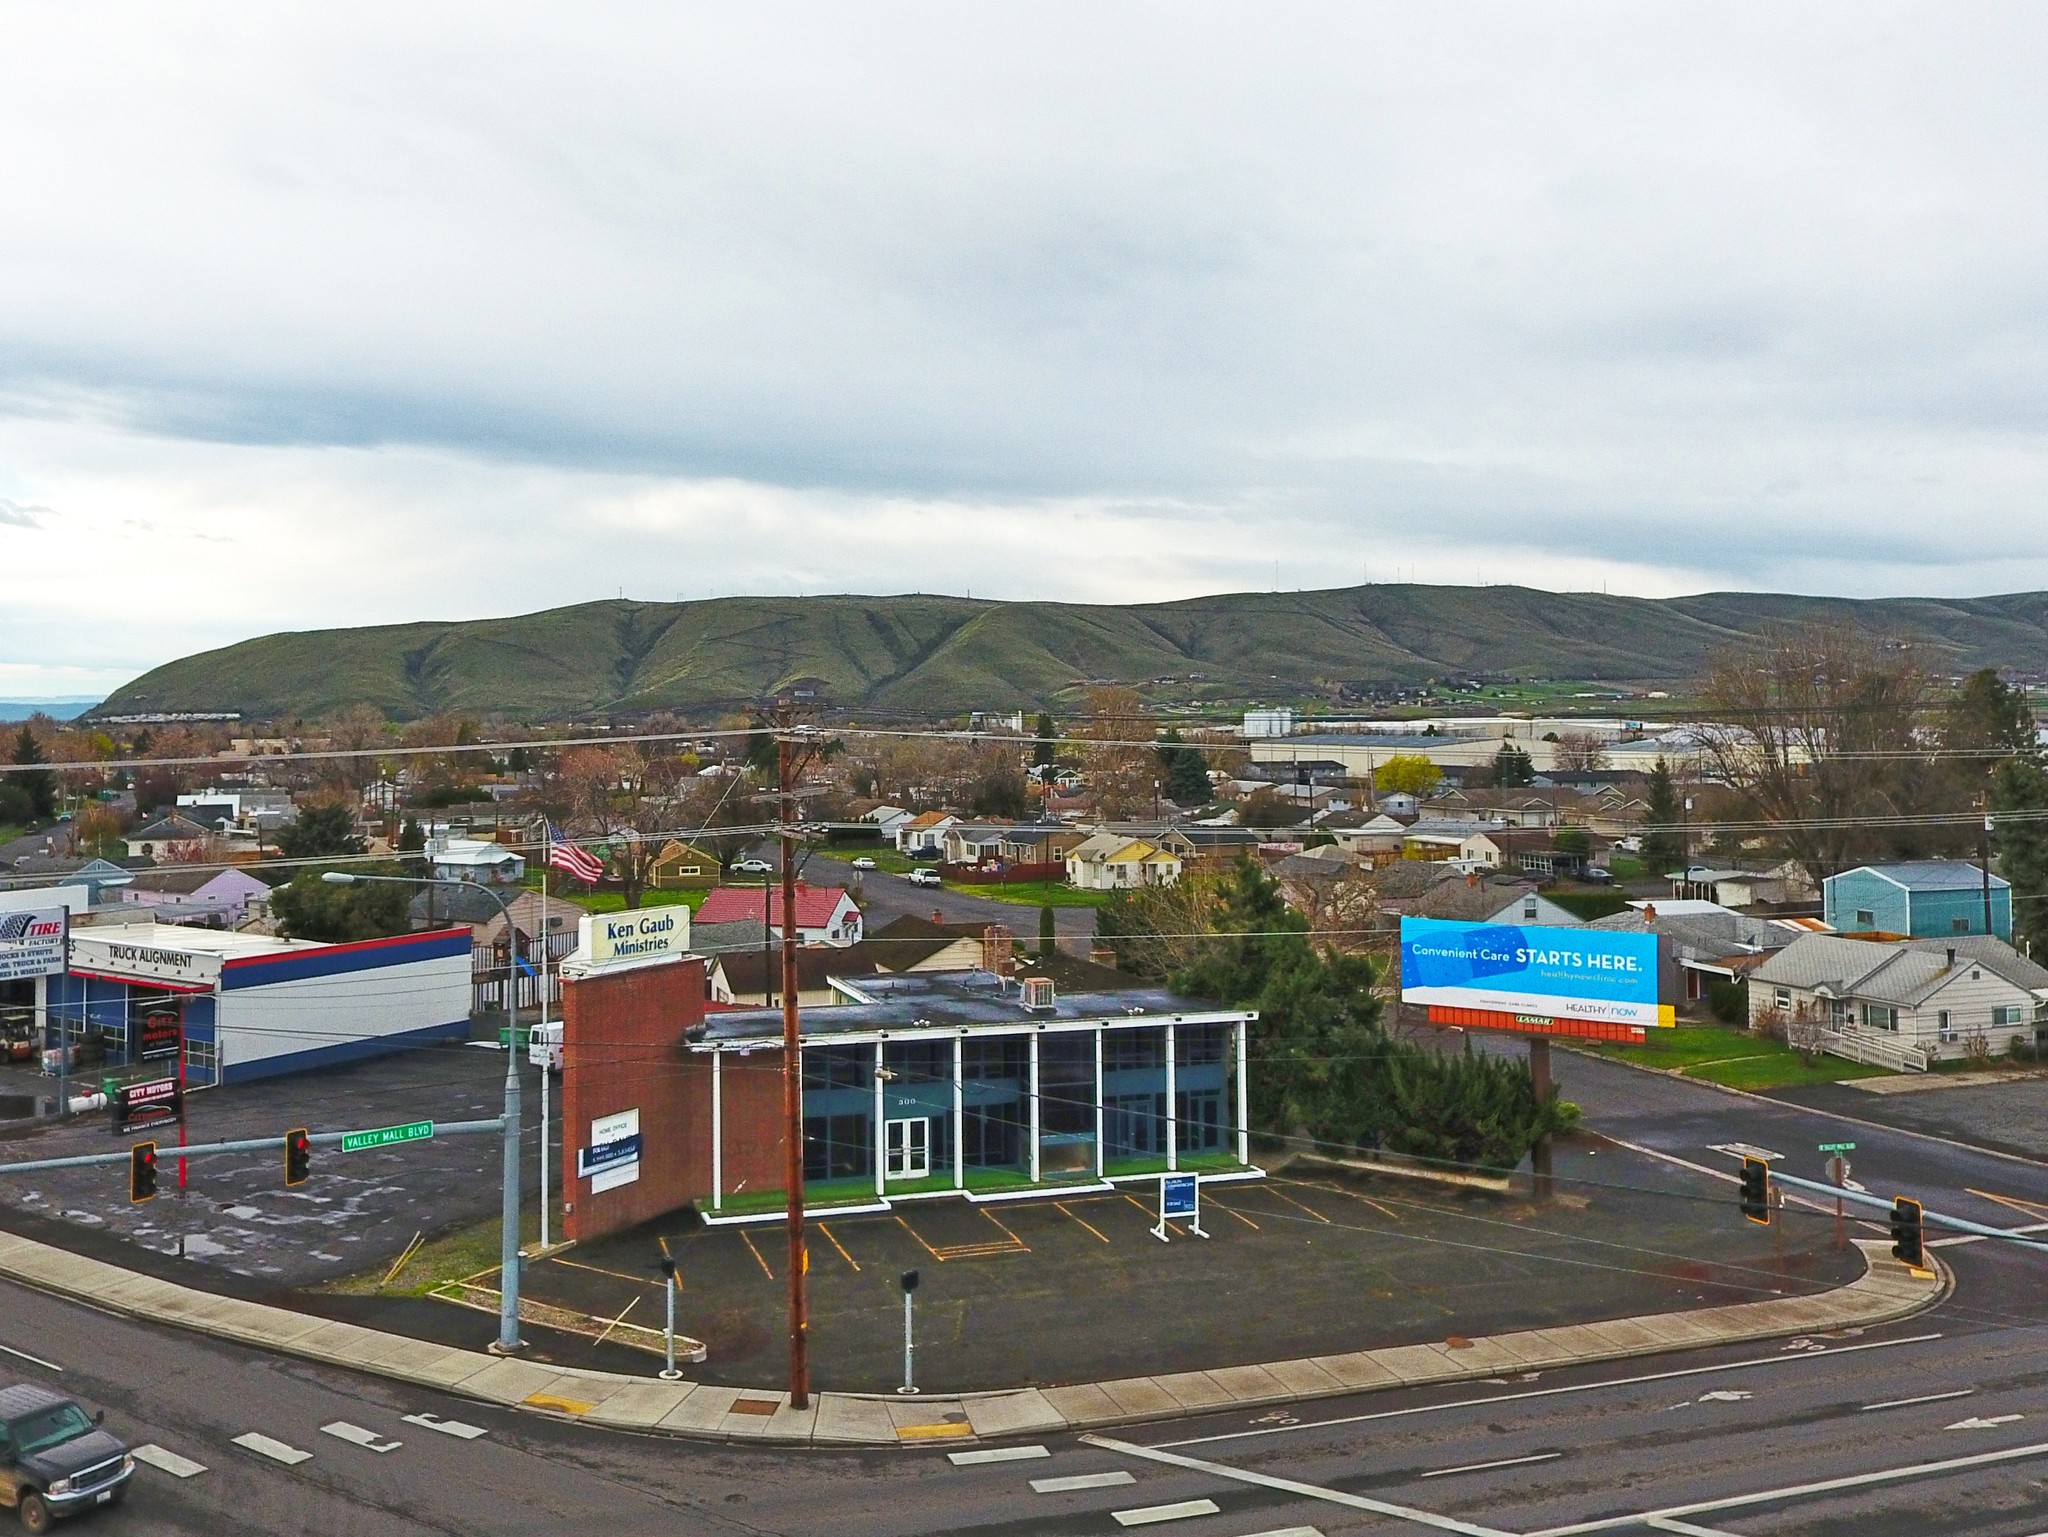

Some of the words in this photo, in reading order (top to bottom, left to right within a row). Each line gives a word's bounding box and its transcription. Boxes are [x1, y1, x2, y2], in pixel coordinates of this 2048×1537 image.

[30, 921, 62, 937] TIRE
[607, 922, 634, 940] Ken
[640, 914, 674, 935] Gaub
[29, 937, 58, 946] FACTORY
[613, 936, 669, 956] Ministries
[27, 948, 53, 957] STRUTS
[108, 945, 137, 961] TRUCK
[139, 949, 193, 968] ALIGNMENT
[1412, 944, 1478, 959] Convenient
[1480, 949, 1510, 962] Care
[1515, 948, 1583, 967] STARTS
[1587, 953, 1643, 972] HERE.
[20, 967, 47, 975] WHEELS
[1566, 1003, 1607, 1014] HEALTHY
[1611, 1007, 1638, 1016] now
[1518, 1016, 1552, 1026] LAMAR
[129, 1088, 145, 1099] CITY
[146, 1082, 173, 1095] MOTORS
[347, 1133, 379, 1148] VALLEY
[382, 1129, 404, 1142] MALL
[408, 1125, 429, 1138] BLVD
